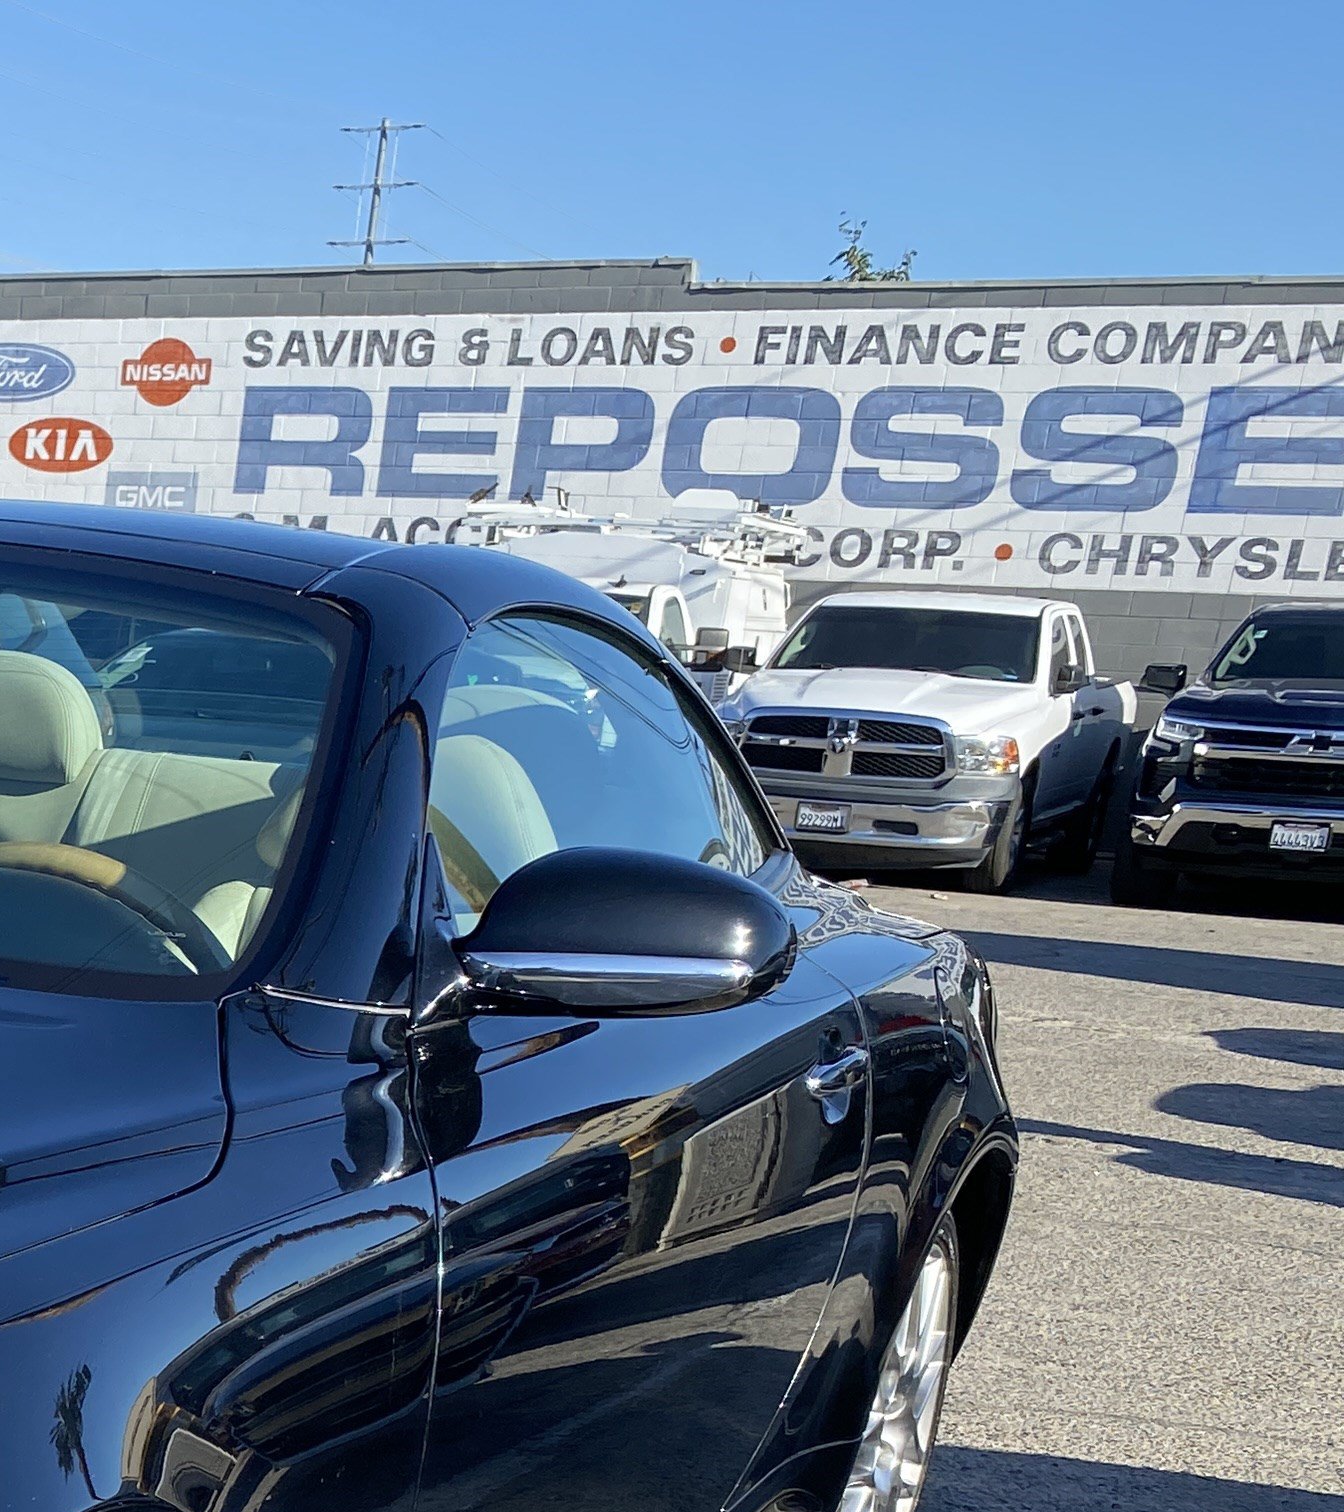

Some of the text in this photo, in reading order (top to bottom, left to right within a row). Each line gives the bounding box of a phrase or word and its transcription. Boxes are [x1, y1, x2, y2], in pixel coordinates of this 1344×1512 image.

[243, 320, 1344, 368] SAVING & LOANS FINANCE COMPAN
[125, 363, 208, 383] NISSAN
[24, 427, 98, 462] KIA
[232, 385, 1344, 517] REPOSSE
[115, 484, 186, 509] GMC
[791, 525, 963, 573] CORP.
